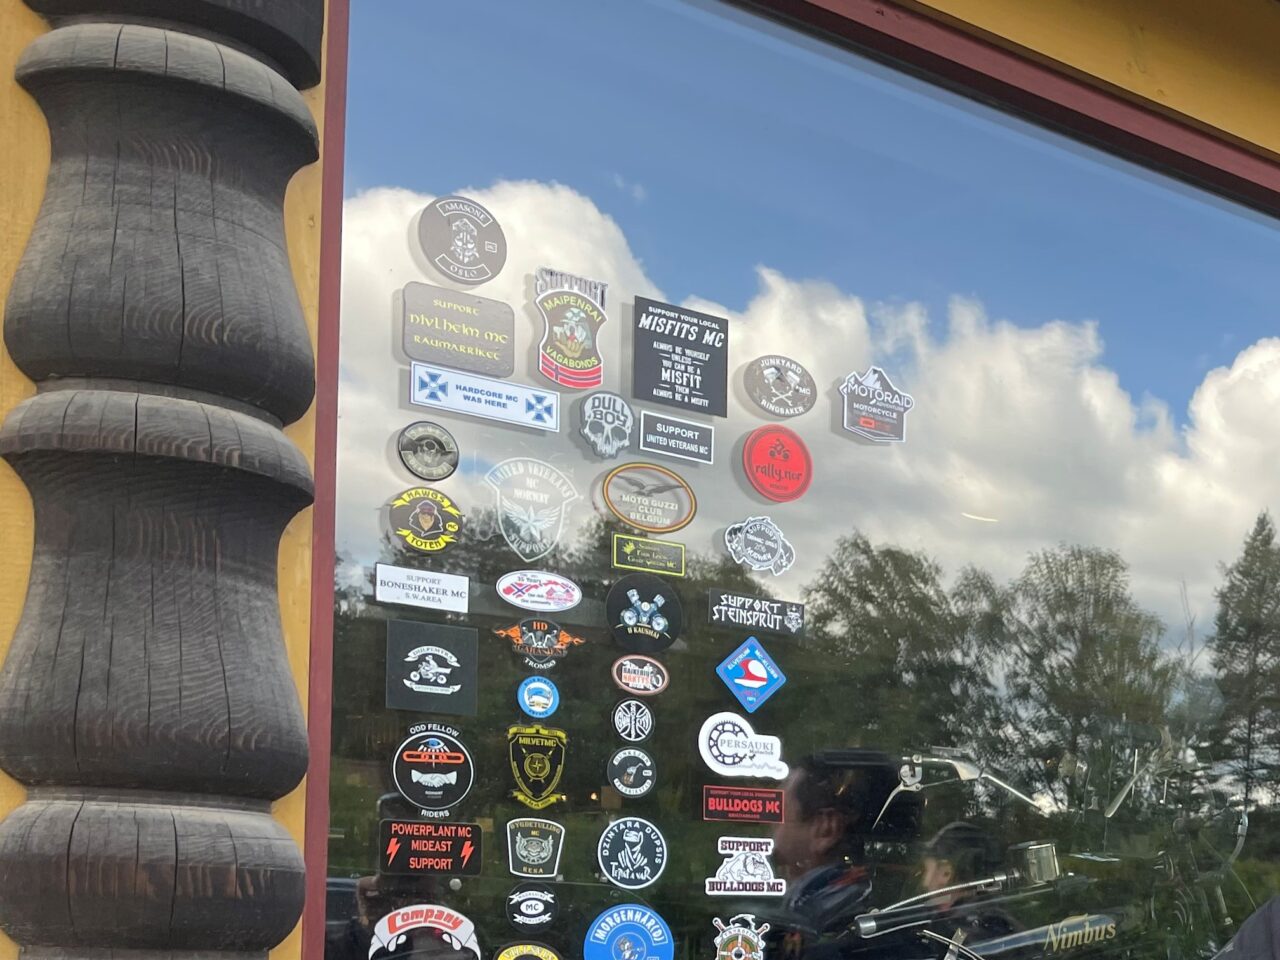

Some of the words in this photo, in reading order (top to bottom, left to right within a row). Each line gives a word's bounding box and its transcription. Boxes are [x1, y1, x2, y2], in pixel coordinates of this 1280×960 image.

[445, 202, 486, 221] AMASONE
[450, 264, 477, 278] OSLO
[536, 267, 608, 311] SUPPORT
[543, 295, 601, 322] MAIPENRAI
[648, 306, 679, 319] SUPPORT
[680, 314, 698, 324] YOUR
[699, 319, 720, 329] LOCAL
[638, 313, 699, 341] MISFITS
[702, 329, 725, 348] MC
[546, 346, 598, 368] VAGABONDS
[760, 357, 803, 375] JUNKYARD
[661, 367, 702, 389] MISFIT
[455, 384, 504, 400] HARDCORE
[506, 395, 519, 403] MC
[463, 394, 482, 403] WAS
[485, 398, 508, 409] HERE
[848, 382, 913, 408] MOTORAID
[592, 409, 628, 427] BOY
[853, 402, 898, 419] MOTORCYCLE
[656, 423, 699, 440] SUPPORT
[646, 434, 668, 446] UNITED
[668, 439, 699, 453] VETERANS
[407, 488, 446, 505] HAWGS
[622, 494, 649, 506] MOTO
[650, 498, 679, 511] GUZZI
[630, 511, 671, 526] BELGIUM
[638, 504, 663, 516] CLUB
[410, 535, 442, 549] TOTEN
[508, 532, 551, 553] SUPPORT
[406, 574, 442, 585] SUPPORT
[380, 579, 450, 597] BONESHAKER
[451, 589, 467, 599] MC
[720, 594, 781, 614] SUPPORT
[533, 621, 548, 631] HD
[712, 605, 782, 630] STEINSPRUT
[409, 724, 426, 735] ODD
[427, 723, 460, 738] FELLOW
[720, 738, 774, 751] PERSAUKI
[420, 809, 450, 818] RIDERS
[708, 797, 763, 813] BULLDOGS
[765, 801, 780, 813] MC
[391, 823, 457, 837] POWERPLANT
[457, 826, 472, 837] MC
[411, 840, 453, 851] MIDEAST
[602, 821, 640, 856] DZINTARA
[645, 826, 663, 864] DUPSIS
[720, 840, 771, 852] SUPPORT
[409, 858, 453, 870] SUPPORT
[708, 881, 764, 892] BULLDOGS
[767, 881, 783, 892] MC
[525, 903, 540, 912] MC
[387, 908, 465, 935] Company
[1044, 913, 1117, 952] Nimbus
